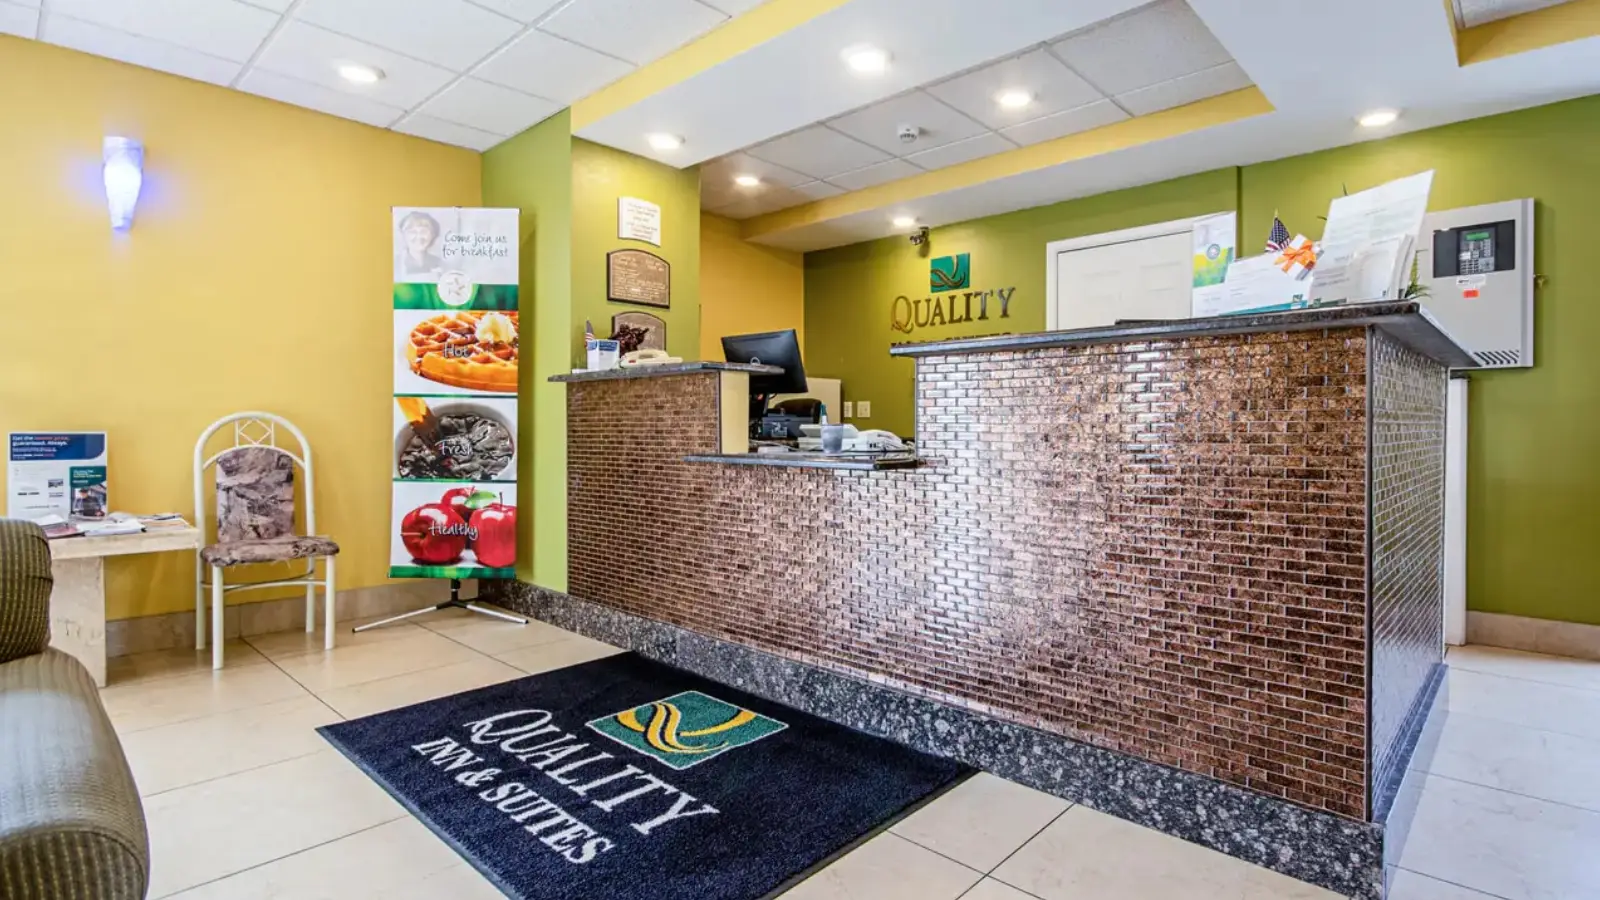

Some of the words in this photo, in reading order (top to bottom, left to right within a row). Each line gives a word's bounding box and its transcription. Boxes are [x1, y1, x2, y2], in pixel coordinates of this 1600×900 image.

[444, 230, 470, 243] Come
[473, 232, 492, 247] join
[494, 235, 508, 243] us
[442, 247, 458, 259] for
[460, 246, 508, 259] breakfast
[891, 287, 1016, 334] QUALITY
[444, 341, 471, 358] Hot
[434, 439, 474, 456] Fresh
[428, 520, 479, 541] Healthy
[463, 709, 721, 835] QUALITY
[411, 736, 485, 772] INN
[455, 768, 503, 787] &
[479, 782, 616, 864] SUITES
